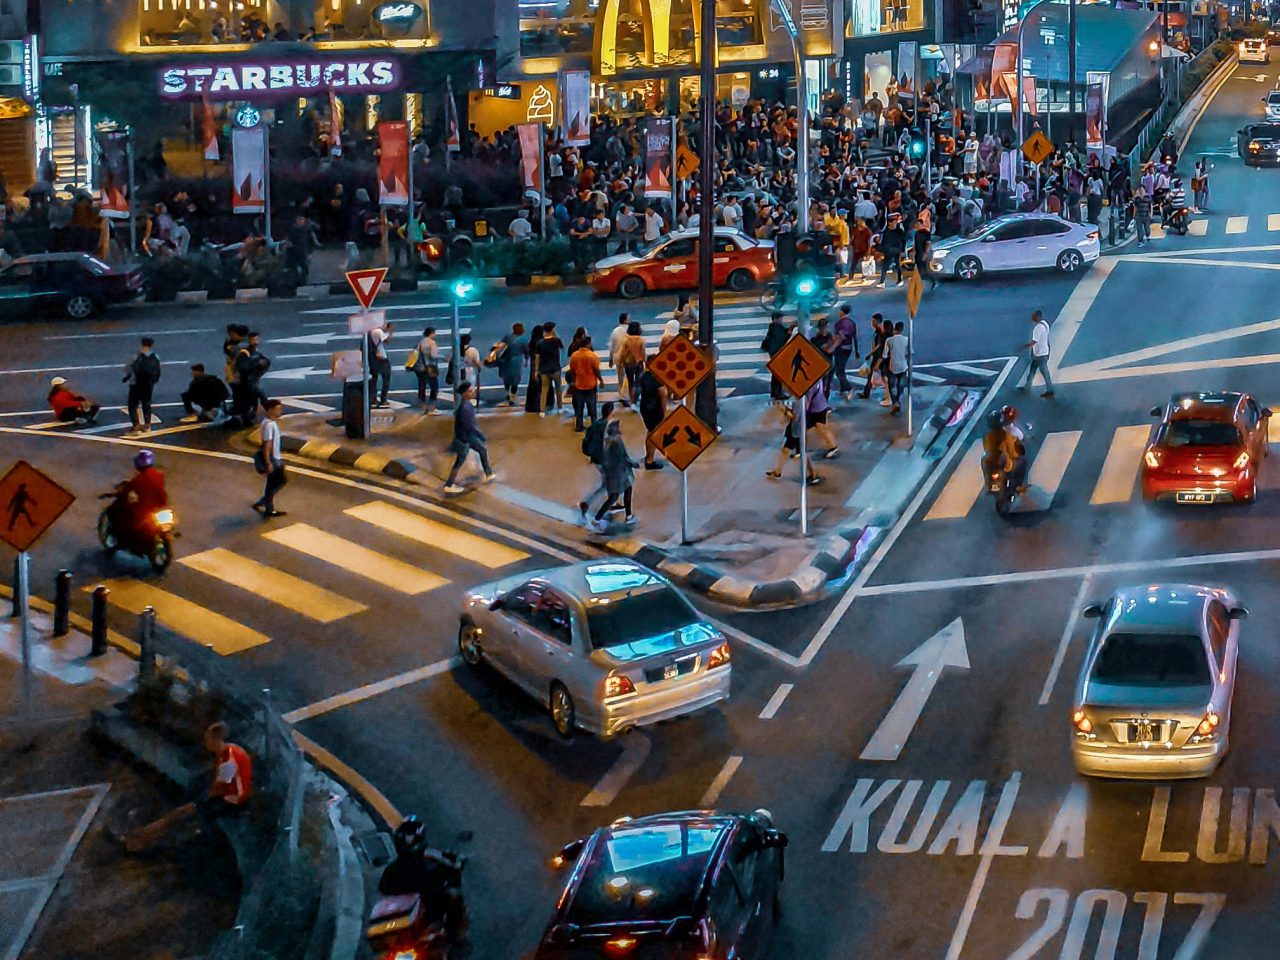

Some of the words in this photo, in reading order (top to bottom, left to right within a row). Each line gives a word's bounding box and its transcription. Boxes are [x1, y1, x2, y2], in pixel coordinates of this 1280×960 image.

[162, 61, 394, 94] STARBUCKS
[821, 772, 1090, 860] KUALA
[1014, 888, 1226, 960] 2017
